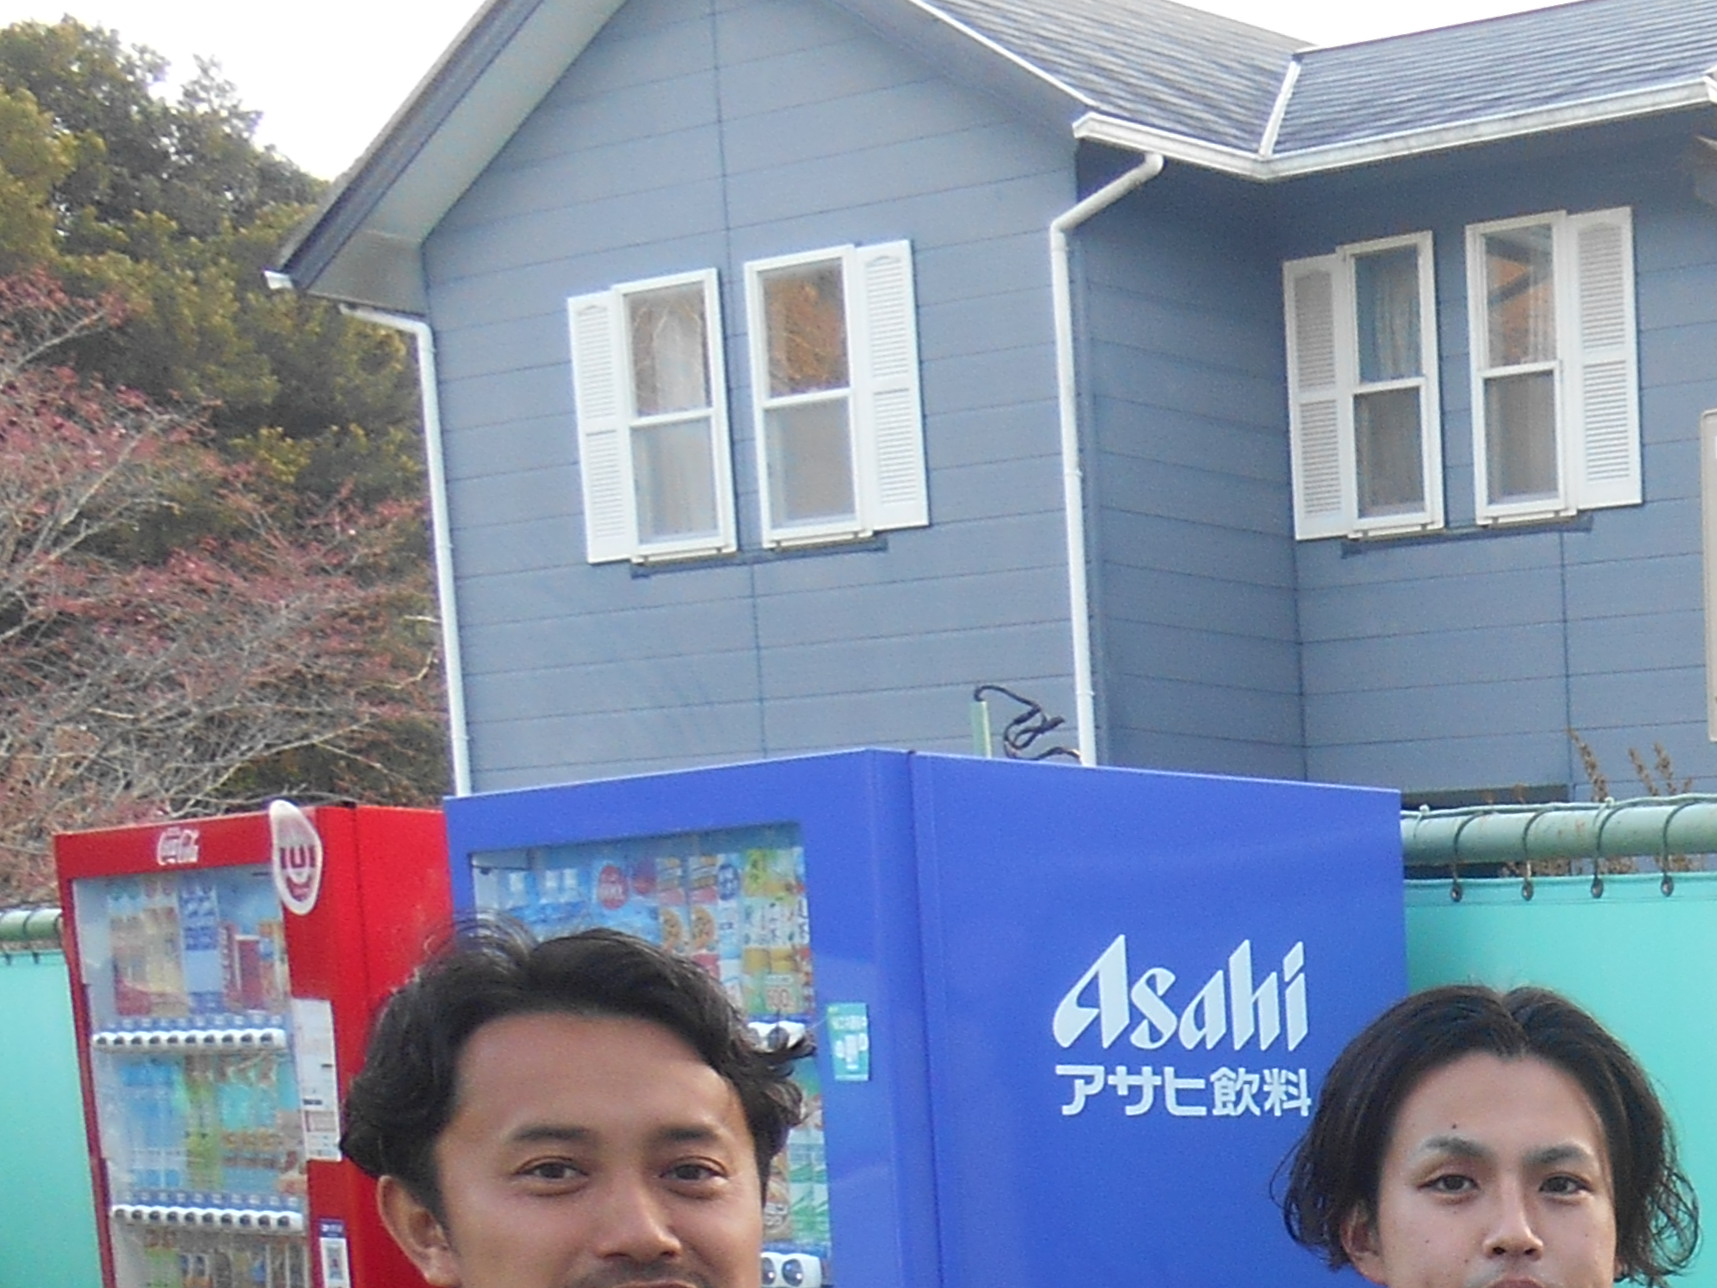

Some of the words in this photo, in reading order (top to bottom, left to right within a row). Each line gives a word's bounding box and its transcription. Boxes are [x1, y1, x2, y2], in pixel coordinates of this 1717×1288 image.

[1053, 934, 1308, 1051] Asahi
[1055, 1064, 1310, 1118] アサヒ飲料
